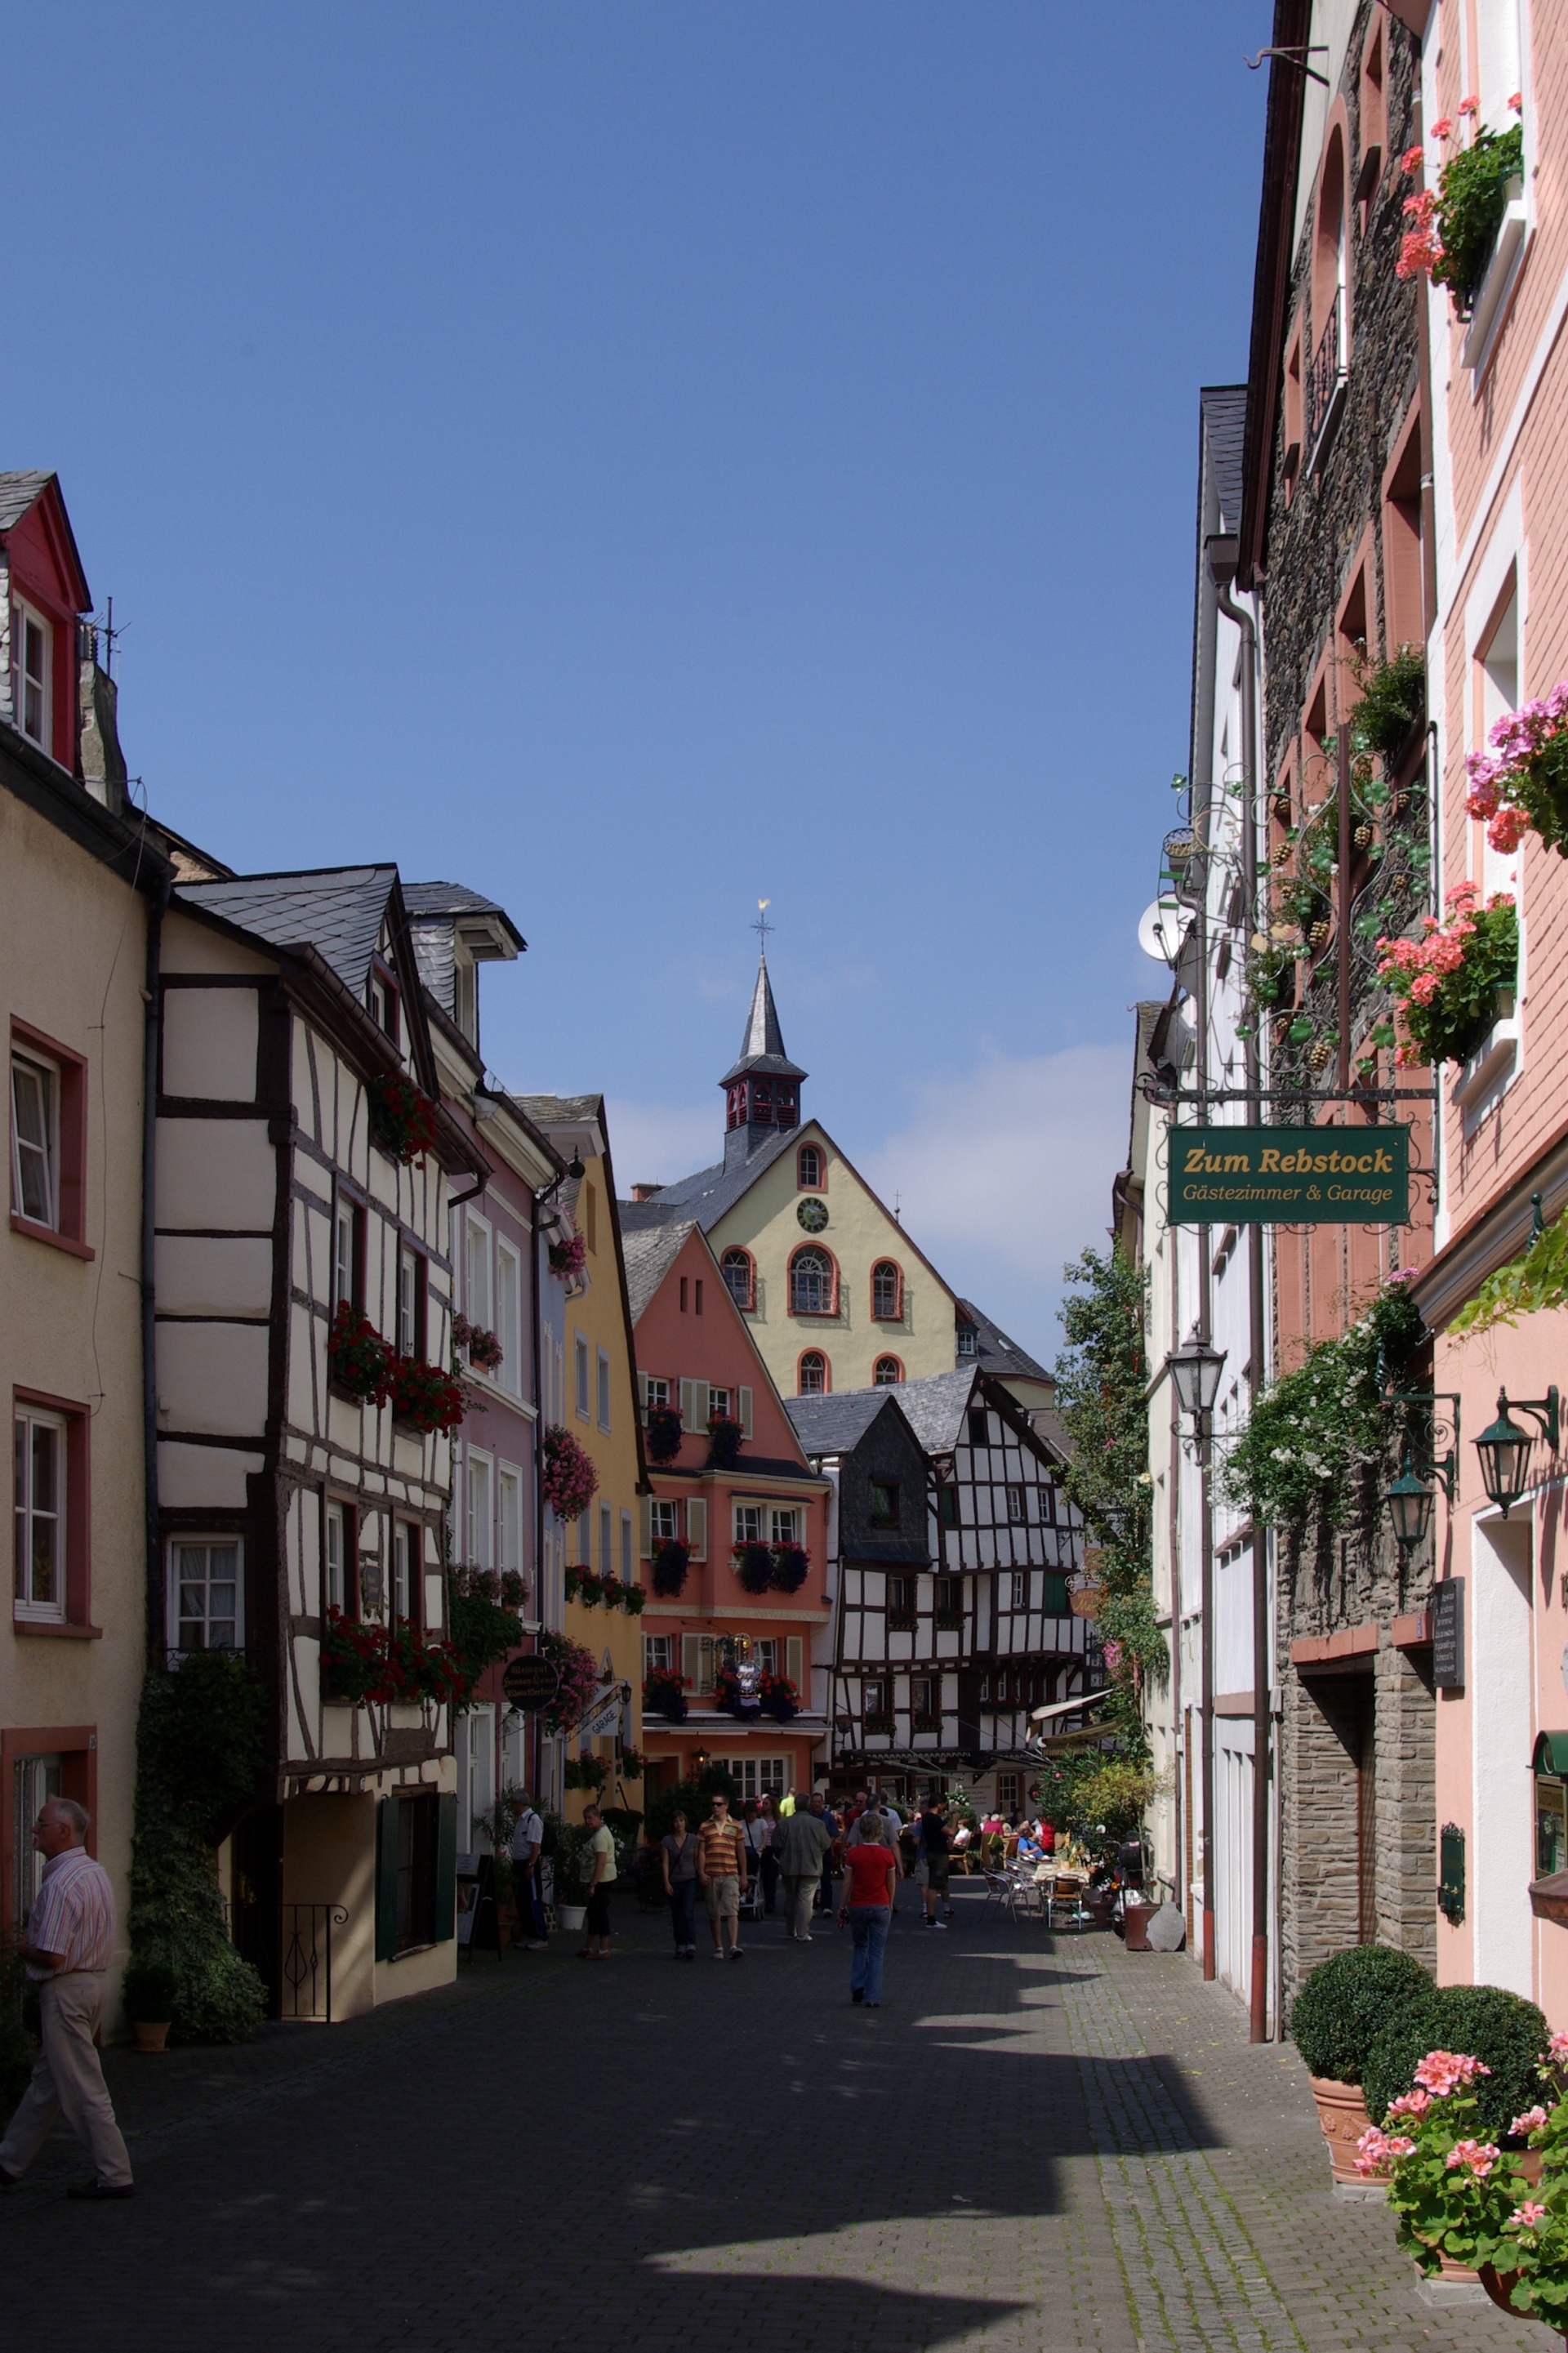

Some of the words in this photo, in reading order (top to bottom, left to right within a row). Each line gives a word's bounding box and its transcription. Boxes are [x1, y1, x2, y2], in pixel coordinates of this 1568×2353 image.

[1183, 1148, 1250, 1173] Zum
[1258, 1148, 1393, 1174] Rebstock
[1183, 1183, 1301, 1201] Gästezimmer
[1305, 1184, 1321, 1201] &
[1326, 1184, 1393, 1205] Garage
[511, 1664, 548, 1674] Weingut
[592, 1710, 617, 1734] GARAGE
